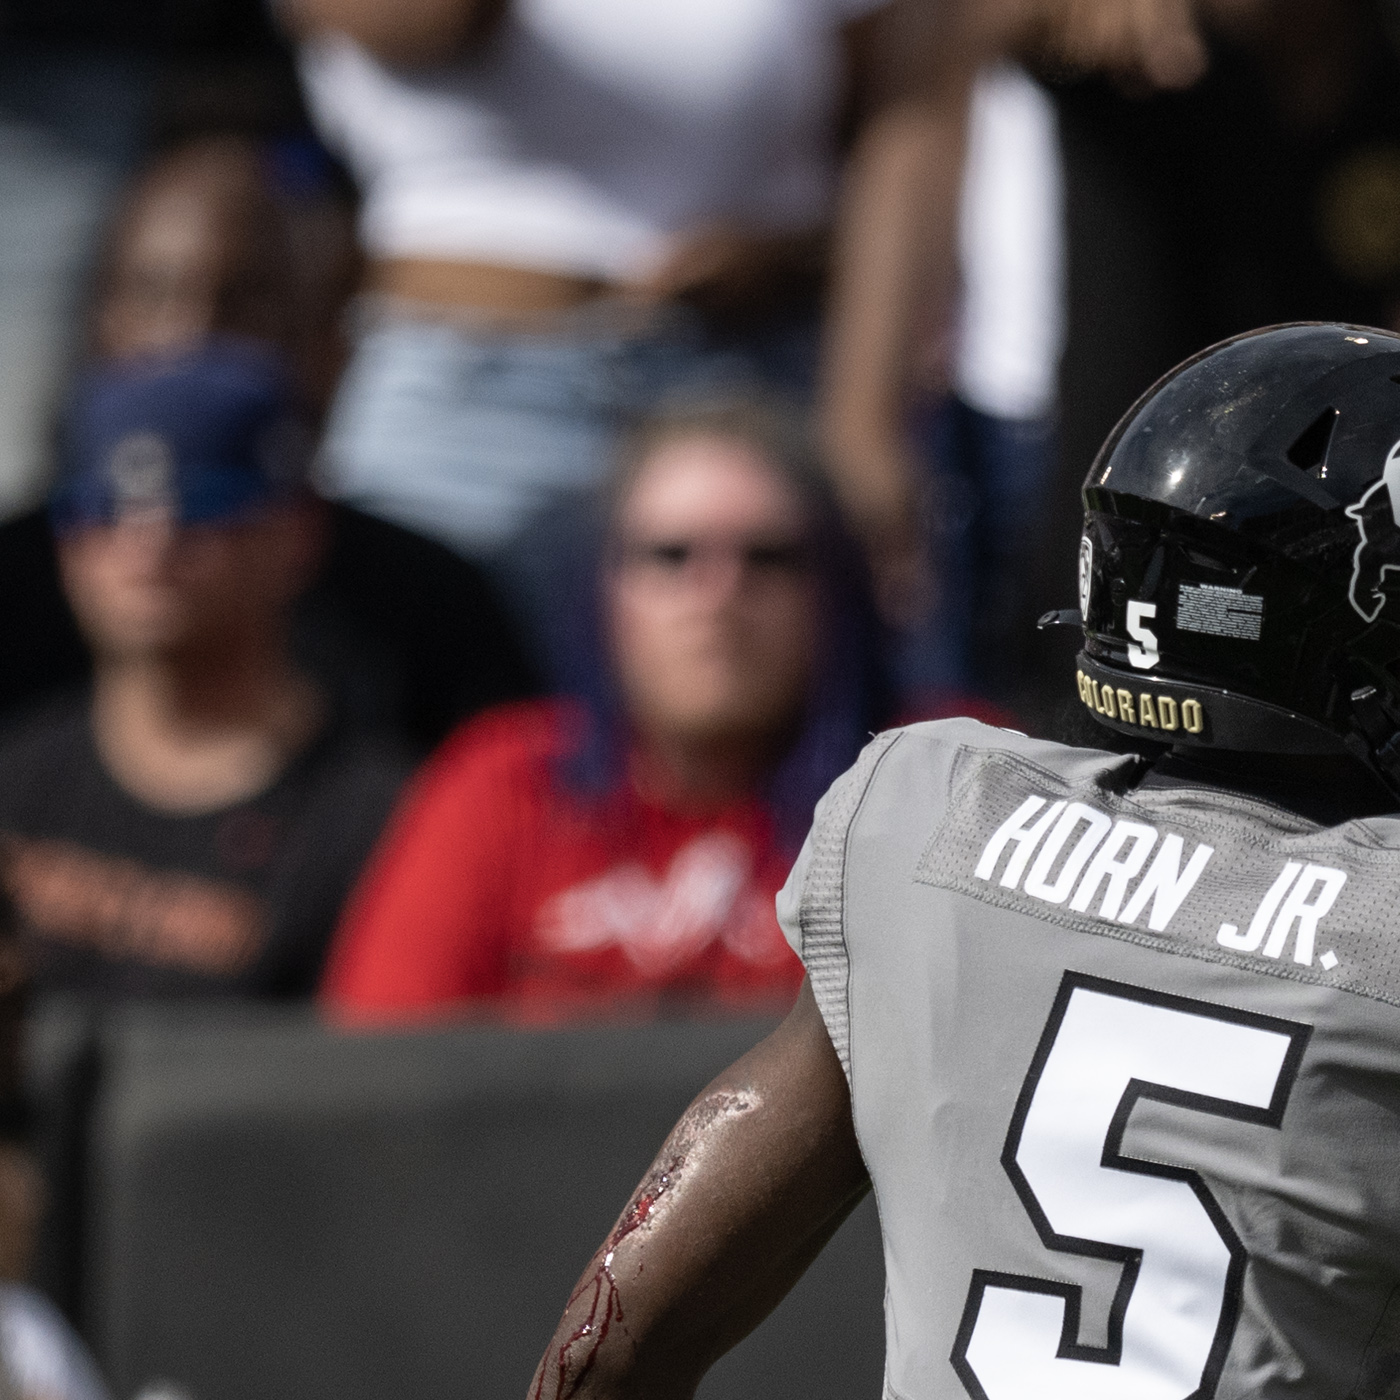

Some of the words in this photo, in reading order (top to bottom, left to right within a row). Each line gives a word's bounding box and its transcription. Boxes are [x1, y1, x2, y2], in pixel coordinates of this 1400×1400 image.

[1126, 600, 1160, 669] 5
[974, 794, 1215, 932] HORN
[1216, 855, 1348, 971] JR.
